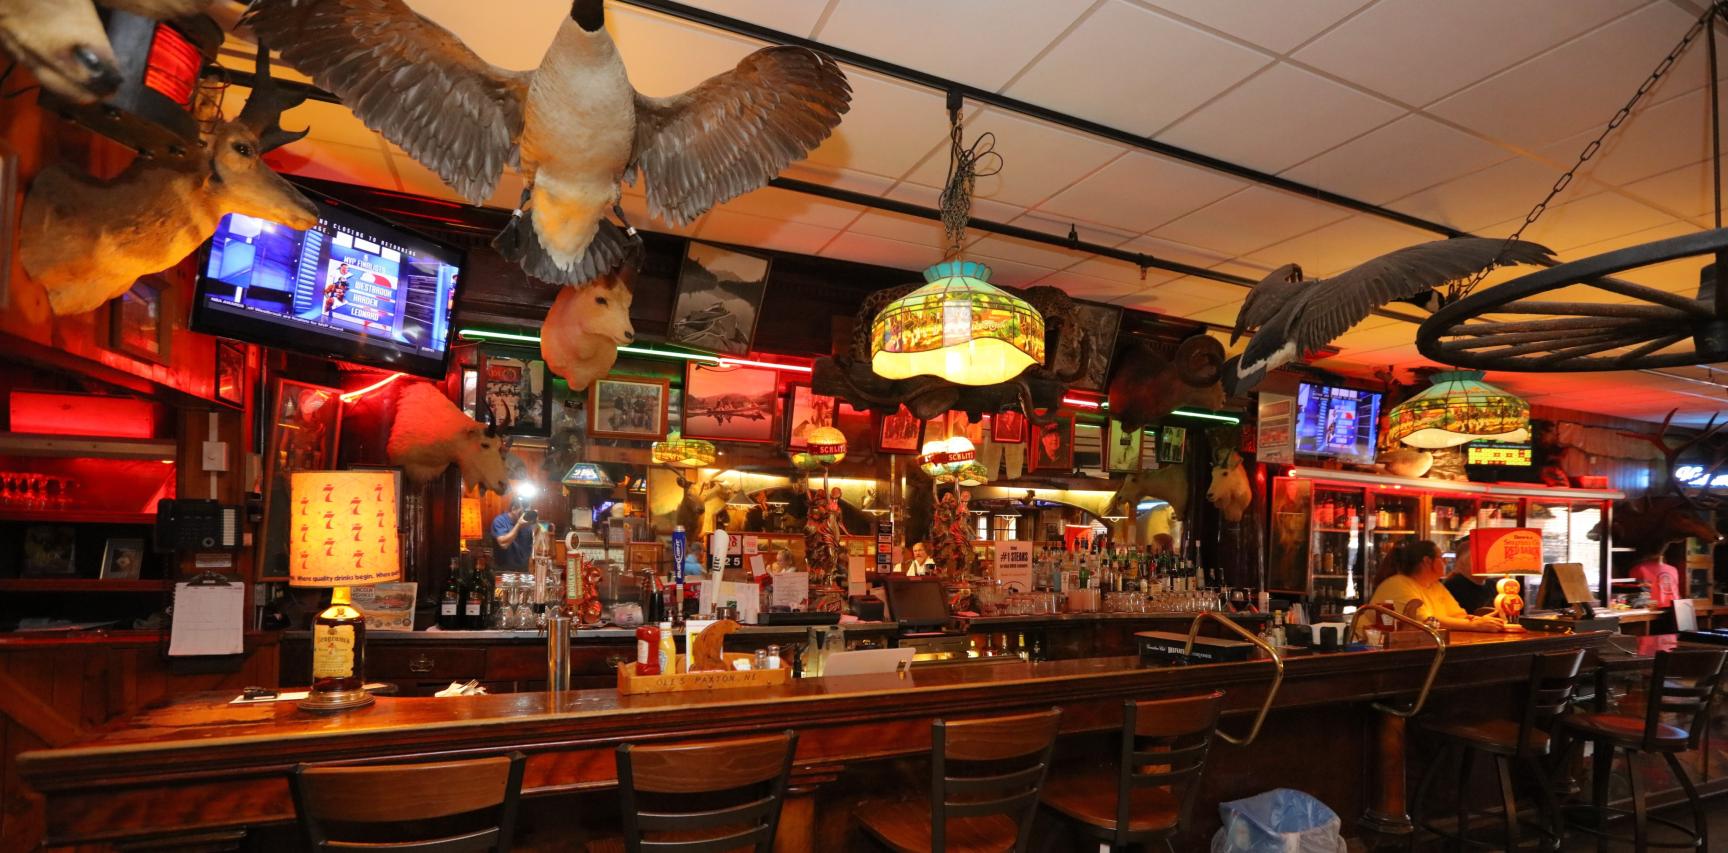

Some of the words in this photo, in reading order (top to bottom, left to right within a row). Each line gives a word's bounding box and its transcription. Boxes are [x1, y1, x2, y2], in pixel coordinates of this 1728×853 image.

[333, 223, 364, 239] CLOSING
[343, 255, 356, 264] MVP
[354, 281, 392, 297] WESTBROOK
[352, 293, 378, 307] HARDEN
[350, 307, 379, 321] LEONARD
[1000, 552, 1010, 562] #1
[1011, 552, 1028, 561] STEAKS
[334, 573, 353, 581] drinks
